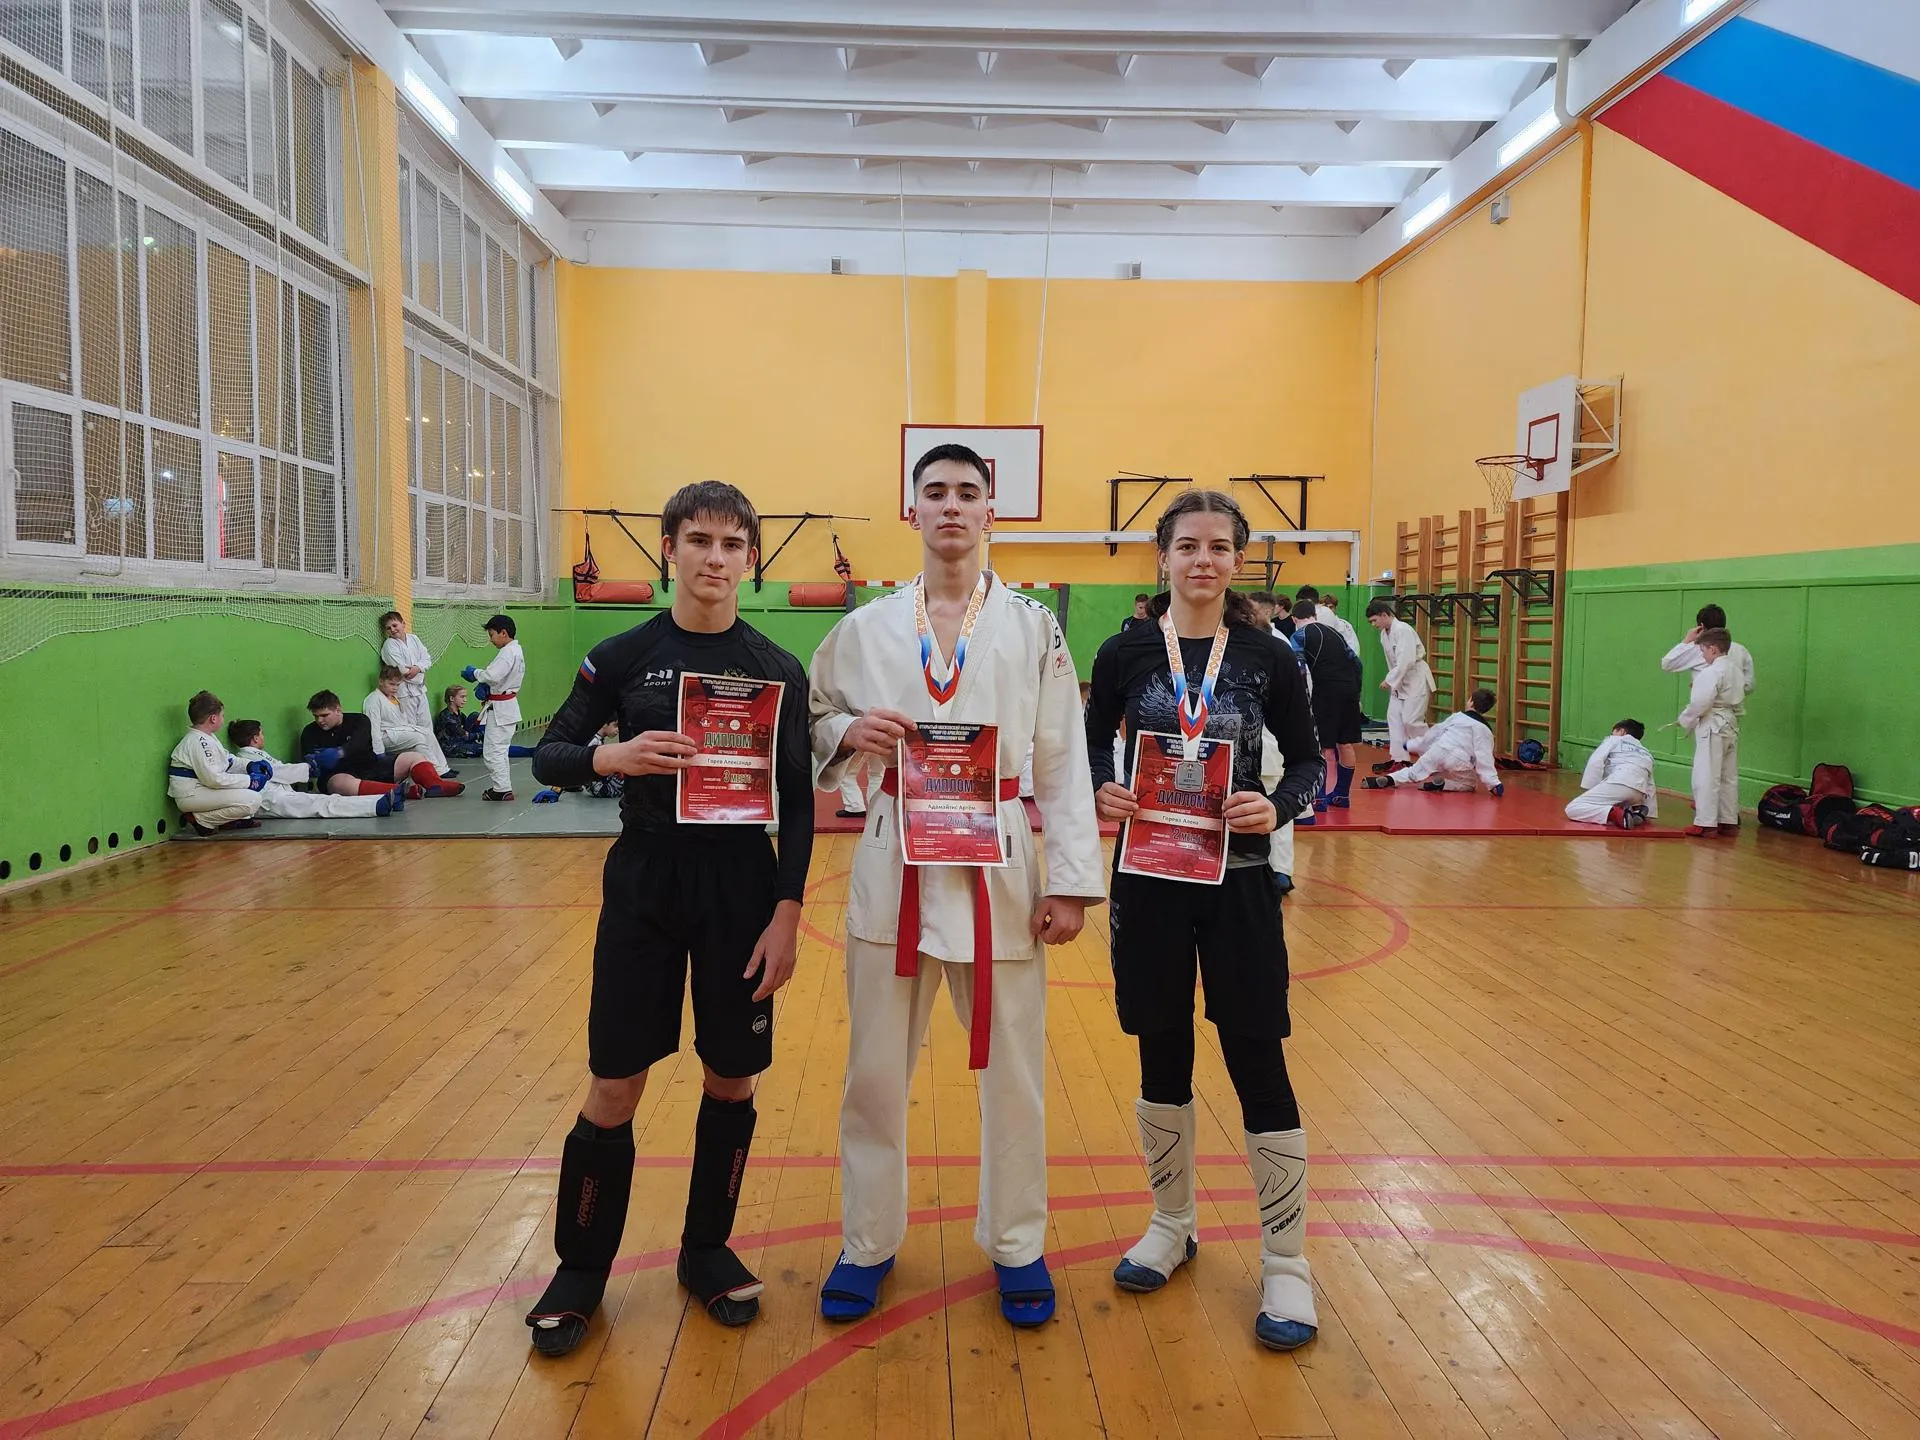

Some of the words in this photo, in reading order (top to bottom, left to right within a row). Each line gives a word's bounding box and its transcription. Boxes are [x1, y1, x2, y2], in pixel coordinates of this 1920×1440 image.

[704, 732, 752, 749] ДИПЛОМ
[723, 770, 731, 783] 3
[925, 778, 974, 793] ДИПЛОМ
[1156, 789, 1206, 808] ДИПЛОМ
[947, 815, 954, 827] 2
[1173, 828, 1180, 841] 2
[728, 1148, 743, 1199] KANGO
[576, 1176, 594, 1227] KANGO
[1270, 1206, 1302, 1235] DEMIX
